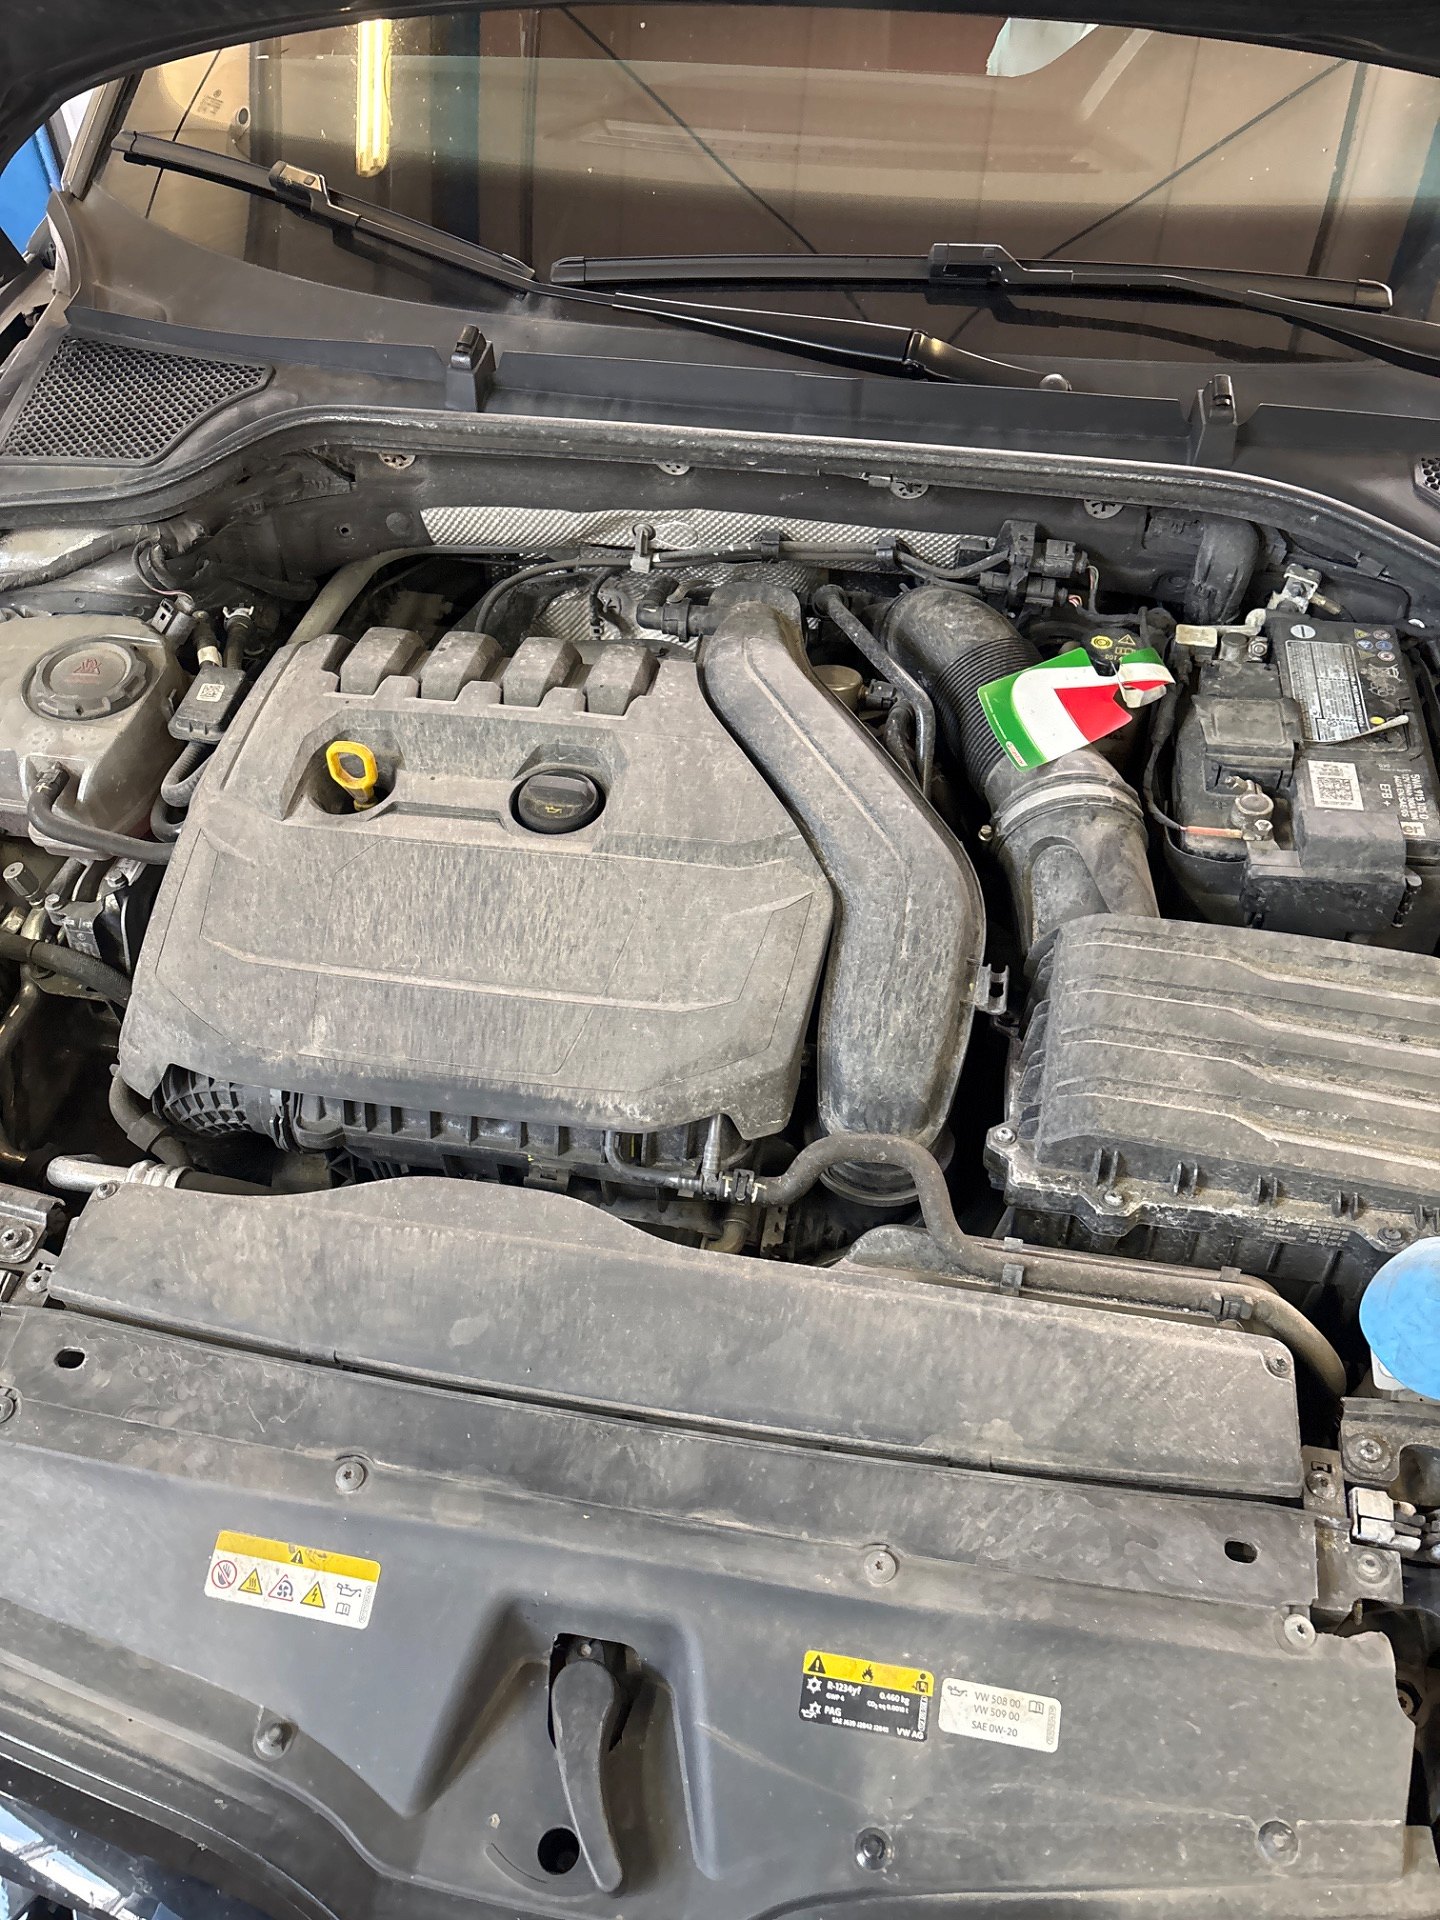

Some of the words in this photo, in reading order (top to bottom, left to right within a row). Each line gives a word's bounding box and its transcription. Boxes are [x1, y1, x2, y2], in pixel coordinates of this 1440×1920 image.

[1380, 783, 1393, 799] EFB
[1414, 789, 1425, 802] 915
[826, 1680, 862, 1697] R-1234yf
[879, 1692, 900, 1703] 0.460
[900, 1695, 910, 1706] kg
[974, 1691, 990, 1702] VW
[991, 1694, 1008, 1706] 508
[1009, 1698, 1021, 1709] 00
[824, 1705, 842, 1717] PAG
[973, 1704, 989, 1715] VW
[990, 1707, 1007, 1719] 509
[1008, 1711, 1020, 1721] 00
[831, 1717, 843, 1725] SAE
[971, 1720, 988, 1731] SAE
[988, 1723, 1018, 1737] 0W-20
[896, 1727, 911, 1737] VW
[911, 1730, 924, 1740] AG
